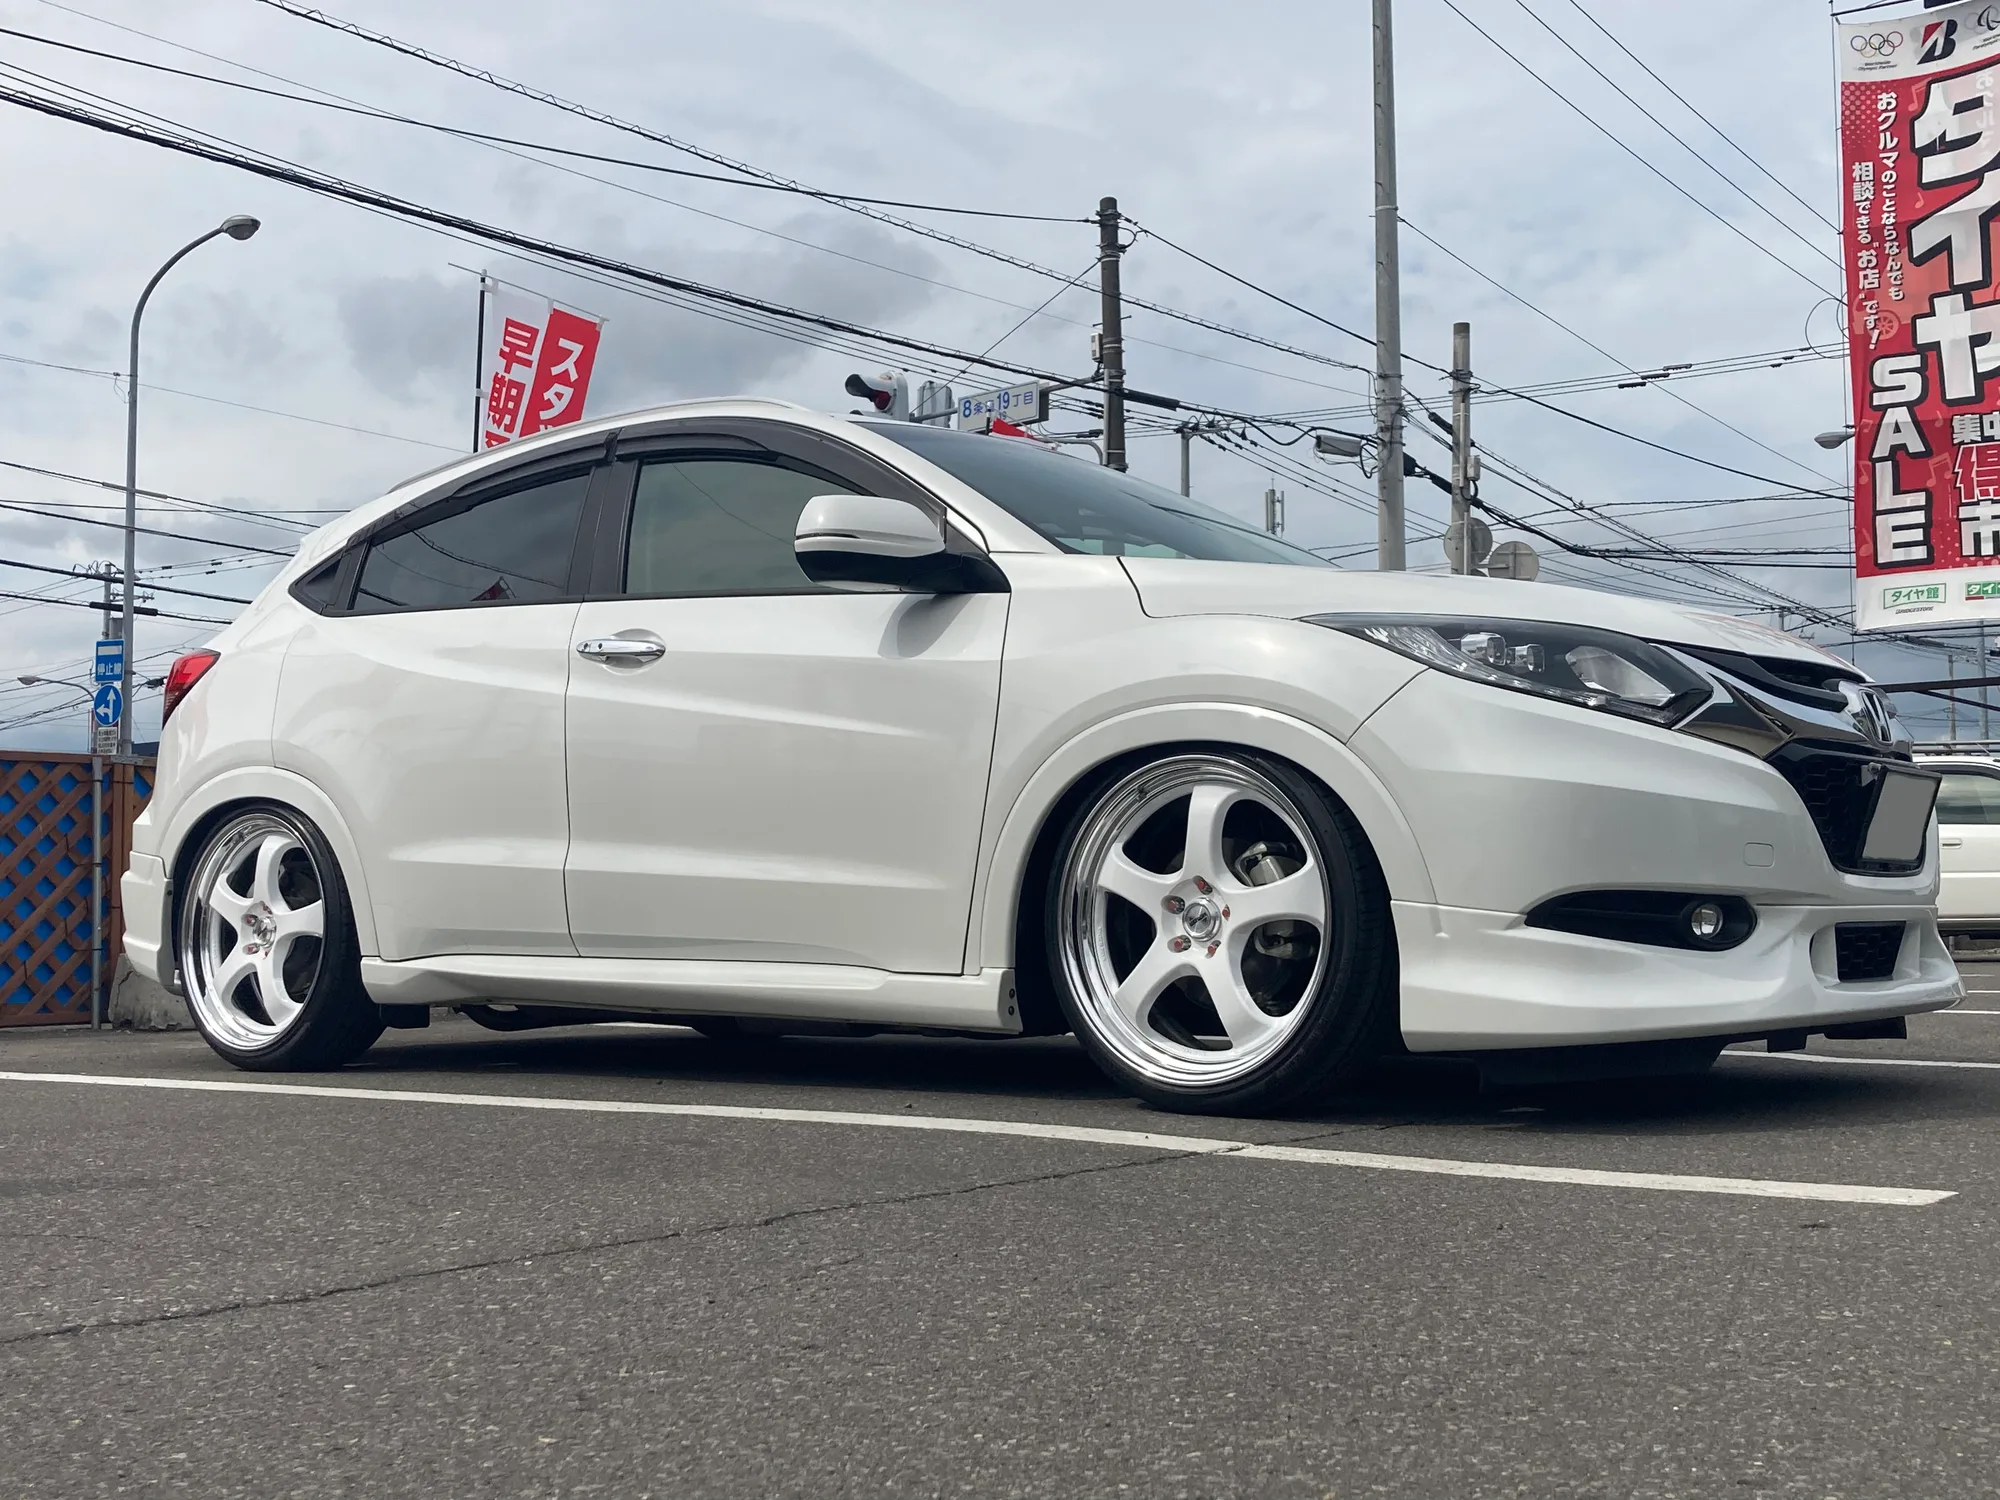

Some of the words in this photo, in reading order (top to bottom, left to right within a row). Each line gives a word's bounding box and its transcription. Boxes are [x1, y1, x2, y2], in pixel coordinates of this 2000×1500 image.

[1877, 91, 1904, 301] おクルマのことならなんでも
[538, 337, 584, 431] スタ
[1872, 354, 1928, 565] SALE
[1891, 586, 1940, 602] タイヤ館
[1967, 582, 2000, 595] タイ
